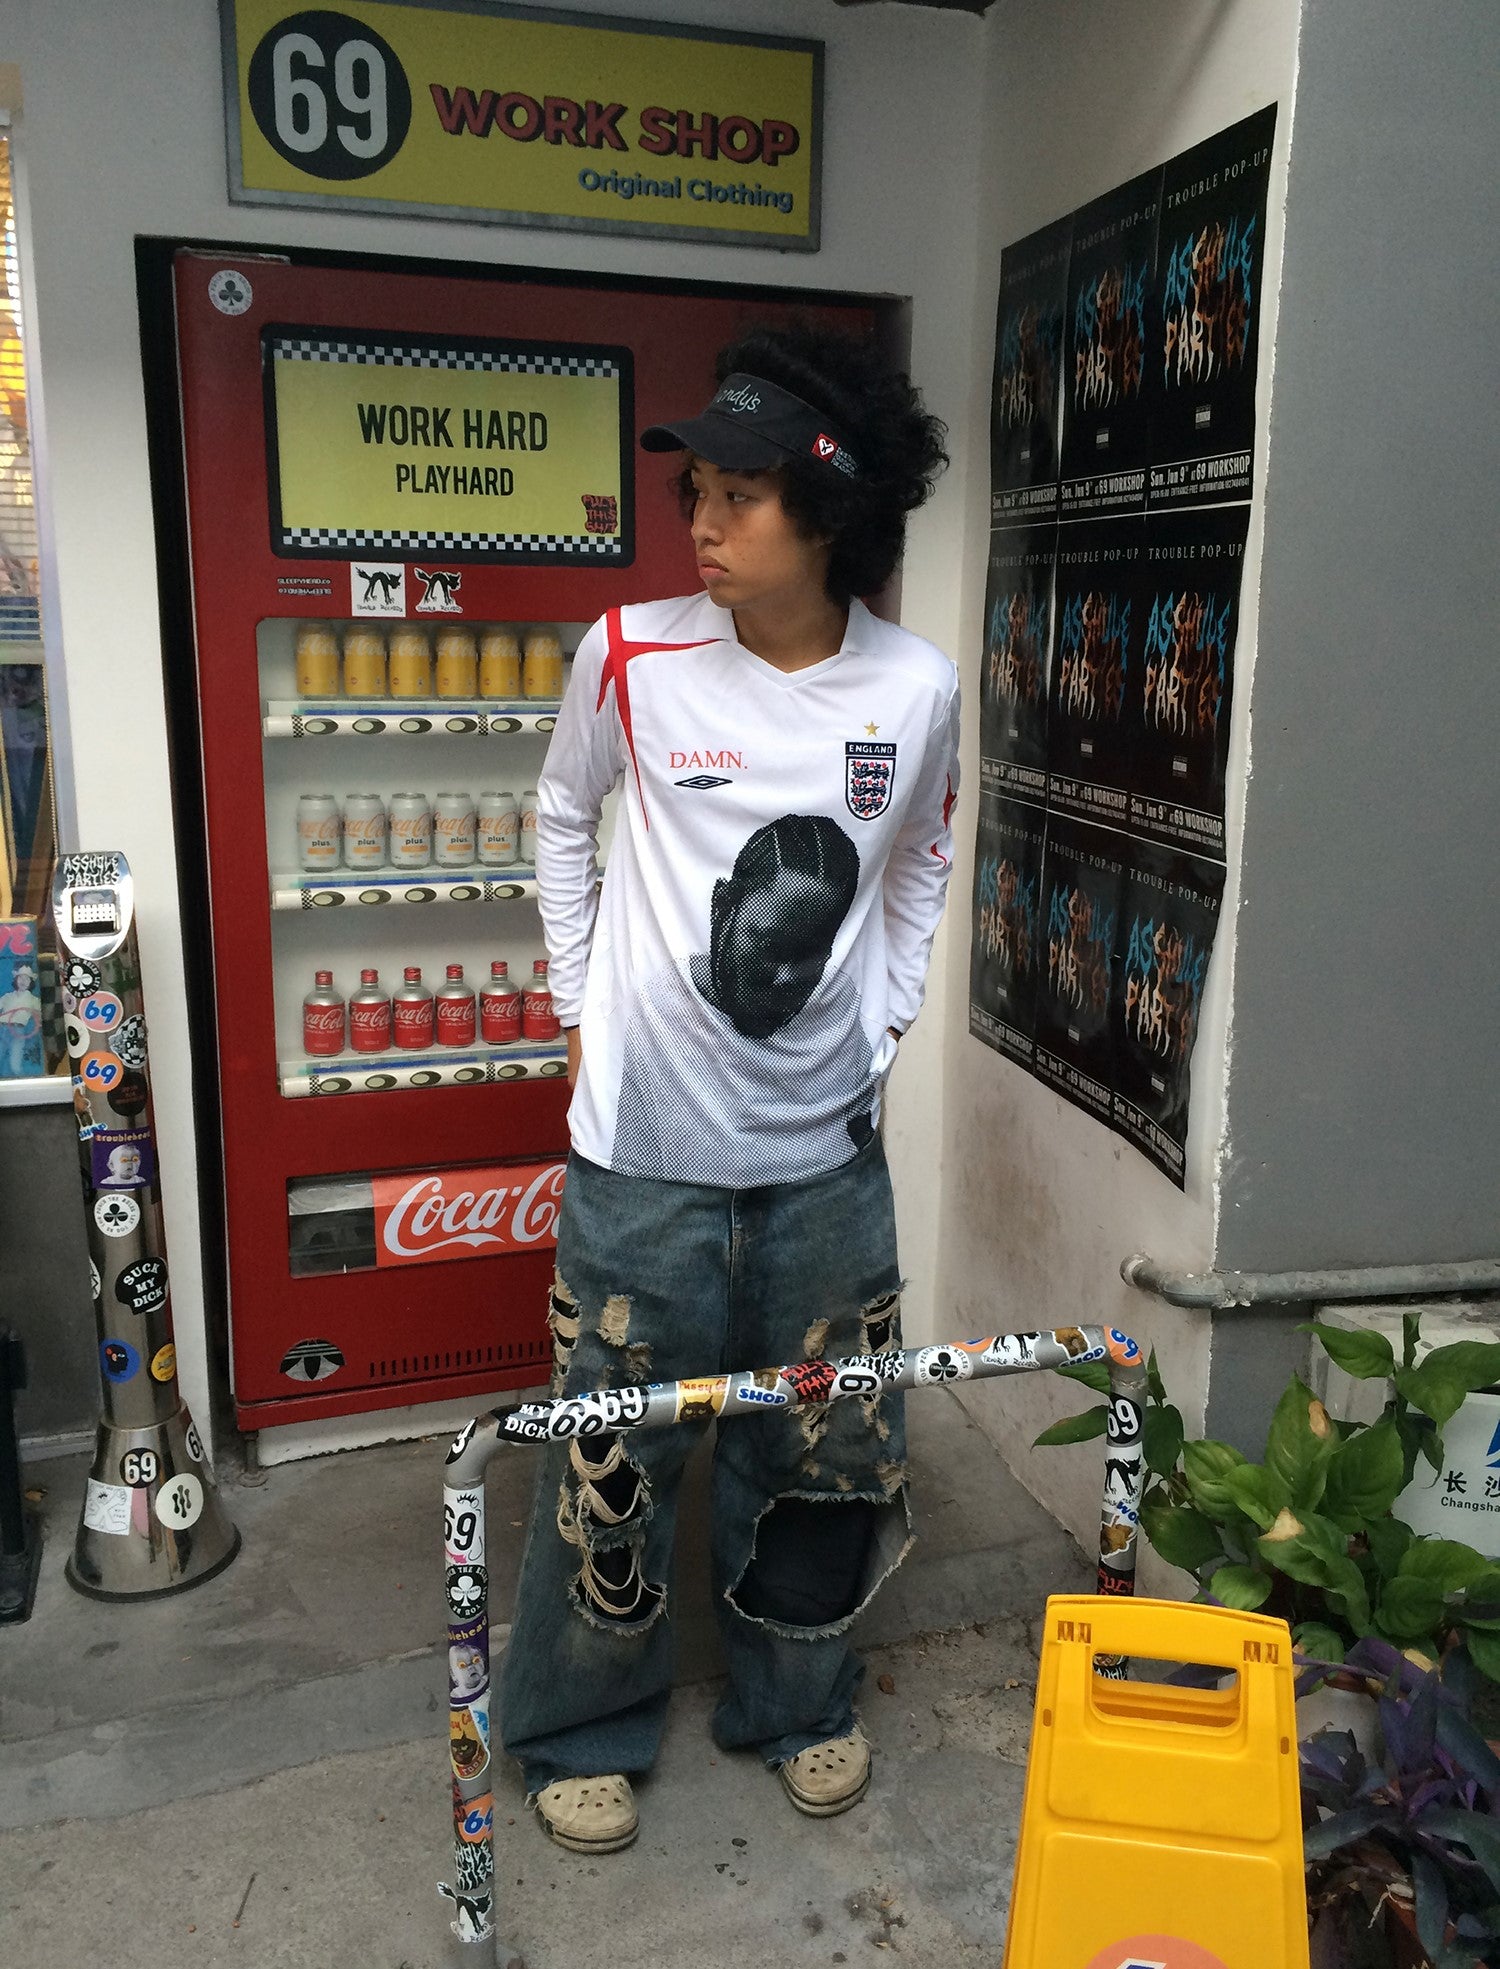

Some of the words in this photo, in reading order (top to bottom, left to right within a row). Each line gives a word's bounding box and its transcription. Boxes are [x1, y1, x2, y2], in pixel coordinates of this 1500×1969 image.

[272, 33, 388, 160] 69
[428, 83, 629, 152] WORK
[638, 106, 800, 167] SHOP
[578, 167, 681, 201] Original
[686, 177, 793, 213] Clothing
[1167, 173, 1218, 209] TROUBLE
[1225, 149, 1269, 181] POP-UP
[1077, 223, 1116, 252] TROUBLE
[357, 403, 453, 448] WORK
[463, 408, 548, 451] HARD
[396, 464, 514, 496] PLAYHARD
[1150, 470, 1165, 487] Sun.
[1196, 462, 1206, 480] 69
[1207, 455, 1250, 479] WORKSHOP
[1099, 479, 1108, 495] 69
[1109, 473, 1145, 493] WORKSHOP
[586, 509, 616, 521] THIS
[1060, 551, 1099, 565] TROUBLE
[1103, 548, 1139, 562] POP-UP
[1148, 545, 1195, 560] TROUBLE
[1200, 543, 1244, 558] POP-UP
[669, 751, 748, 769] DAMN.
[849, 744, 893, 754] ENGLAND
[1093, 788, 1127, 810] WORKSHOP
[1174, 808, 1183, 826] 69
[1184, 811, 1223, 837] WORKSHOP
[311, 838, 331, 847] plus
[357, 838, 376, 847] plus
[405, 836, 424, 846] plus
[450, 835, 468, 845] plus
[487, 834, 505, 844] plus
[63, 855, 119, 874] ASSHOLE
[1049, 841, 1085, 863] TROUBLE
[1089, 854, 1123, 875] POP-UP
[65, 871, 120, 888] PARTIES
[1129, 868, 1174, 894] TROUBLE
[1178, 887, 1218, 911] POP-UP
[85, 1000, 117, 1023] 69
[86, 1059, 117, 1084] 69
[384, 1165, 568, 1256] Coca-C
[123, 1262, 160, 1286] SUCK
[135, 1277, 155, 1293] MY
[133, 1286, 163, 1308] DICK
[599, 1386, 644, 1422] 69
[739, 1388, 785, 1403] SHOP
[519, 1404, 550, 1418] MY
[504, 1416, 549, 1439] DICK
[124, 1452, 156, 1484] 69
